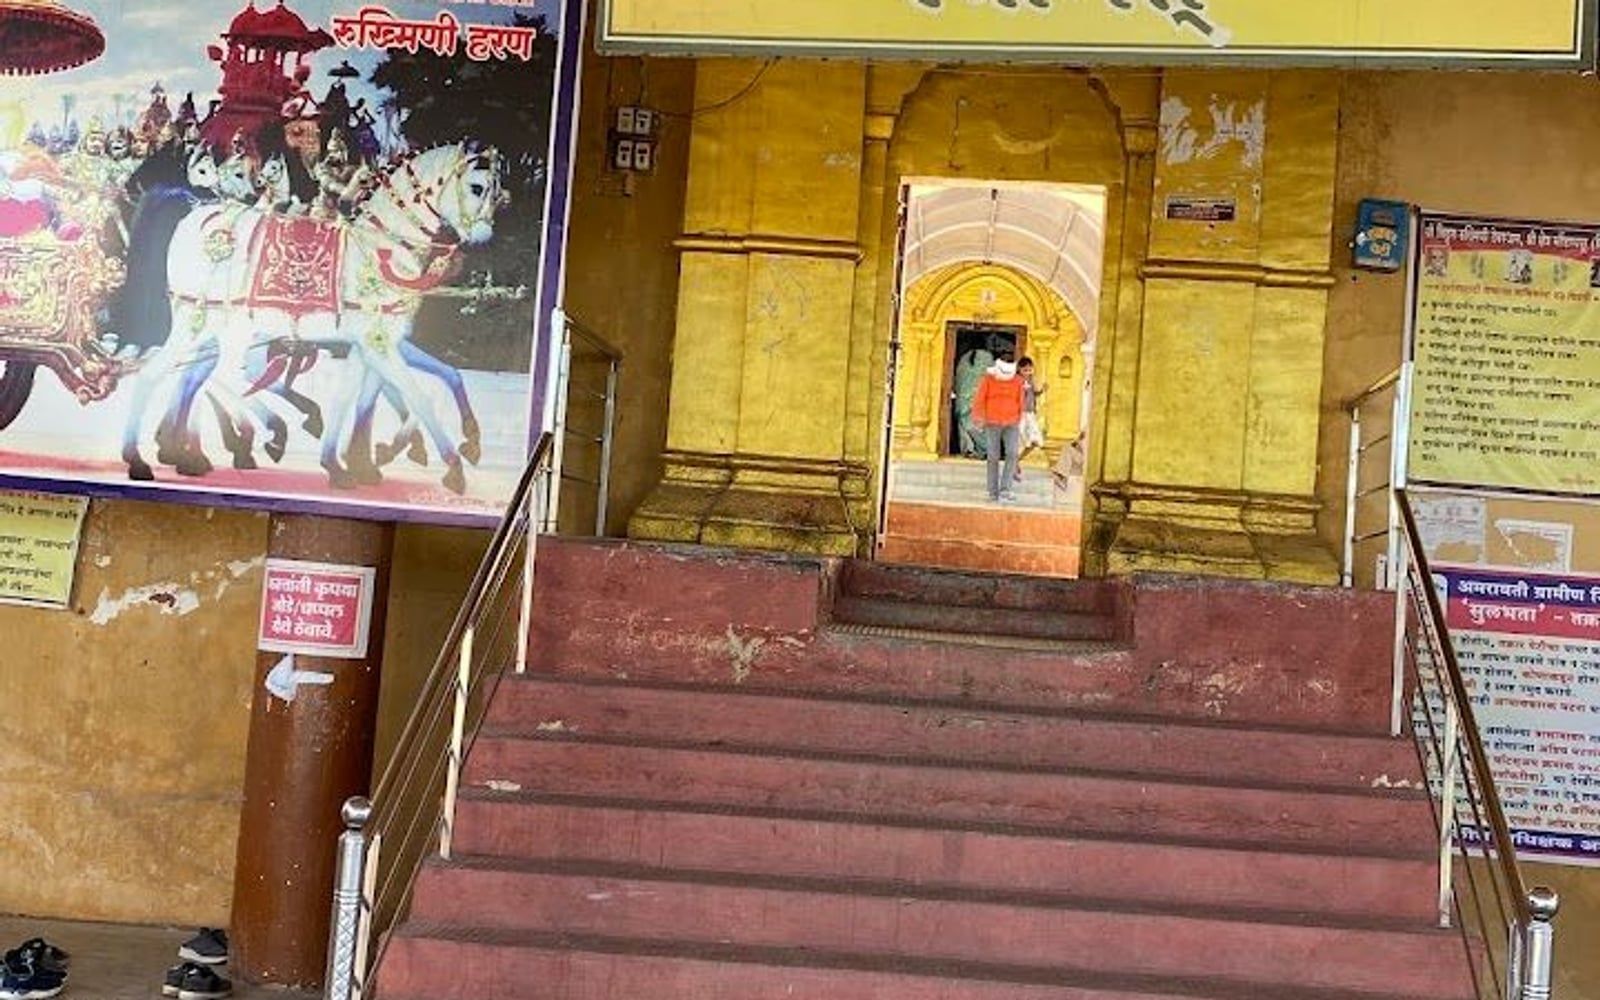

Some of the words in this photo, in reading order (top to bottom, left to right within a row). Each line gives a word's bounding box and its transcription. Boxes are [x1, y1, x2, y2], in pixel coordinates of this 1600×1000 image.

[467, 27, 535, 62] हरण
[314, 582, 358, 601] कृपया
[1458, 580, 1529, 598] अमरावती
[1534, 583, 1585, 602] ग्रामीण
